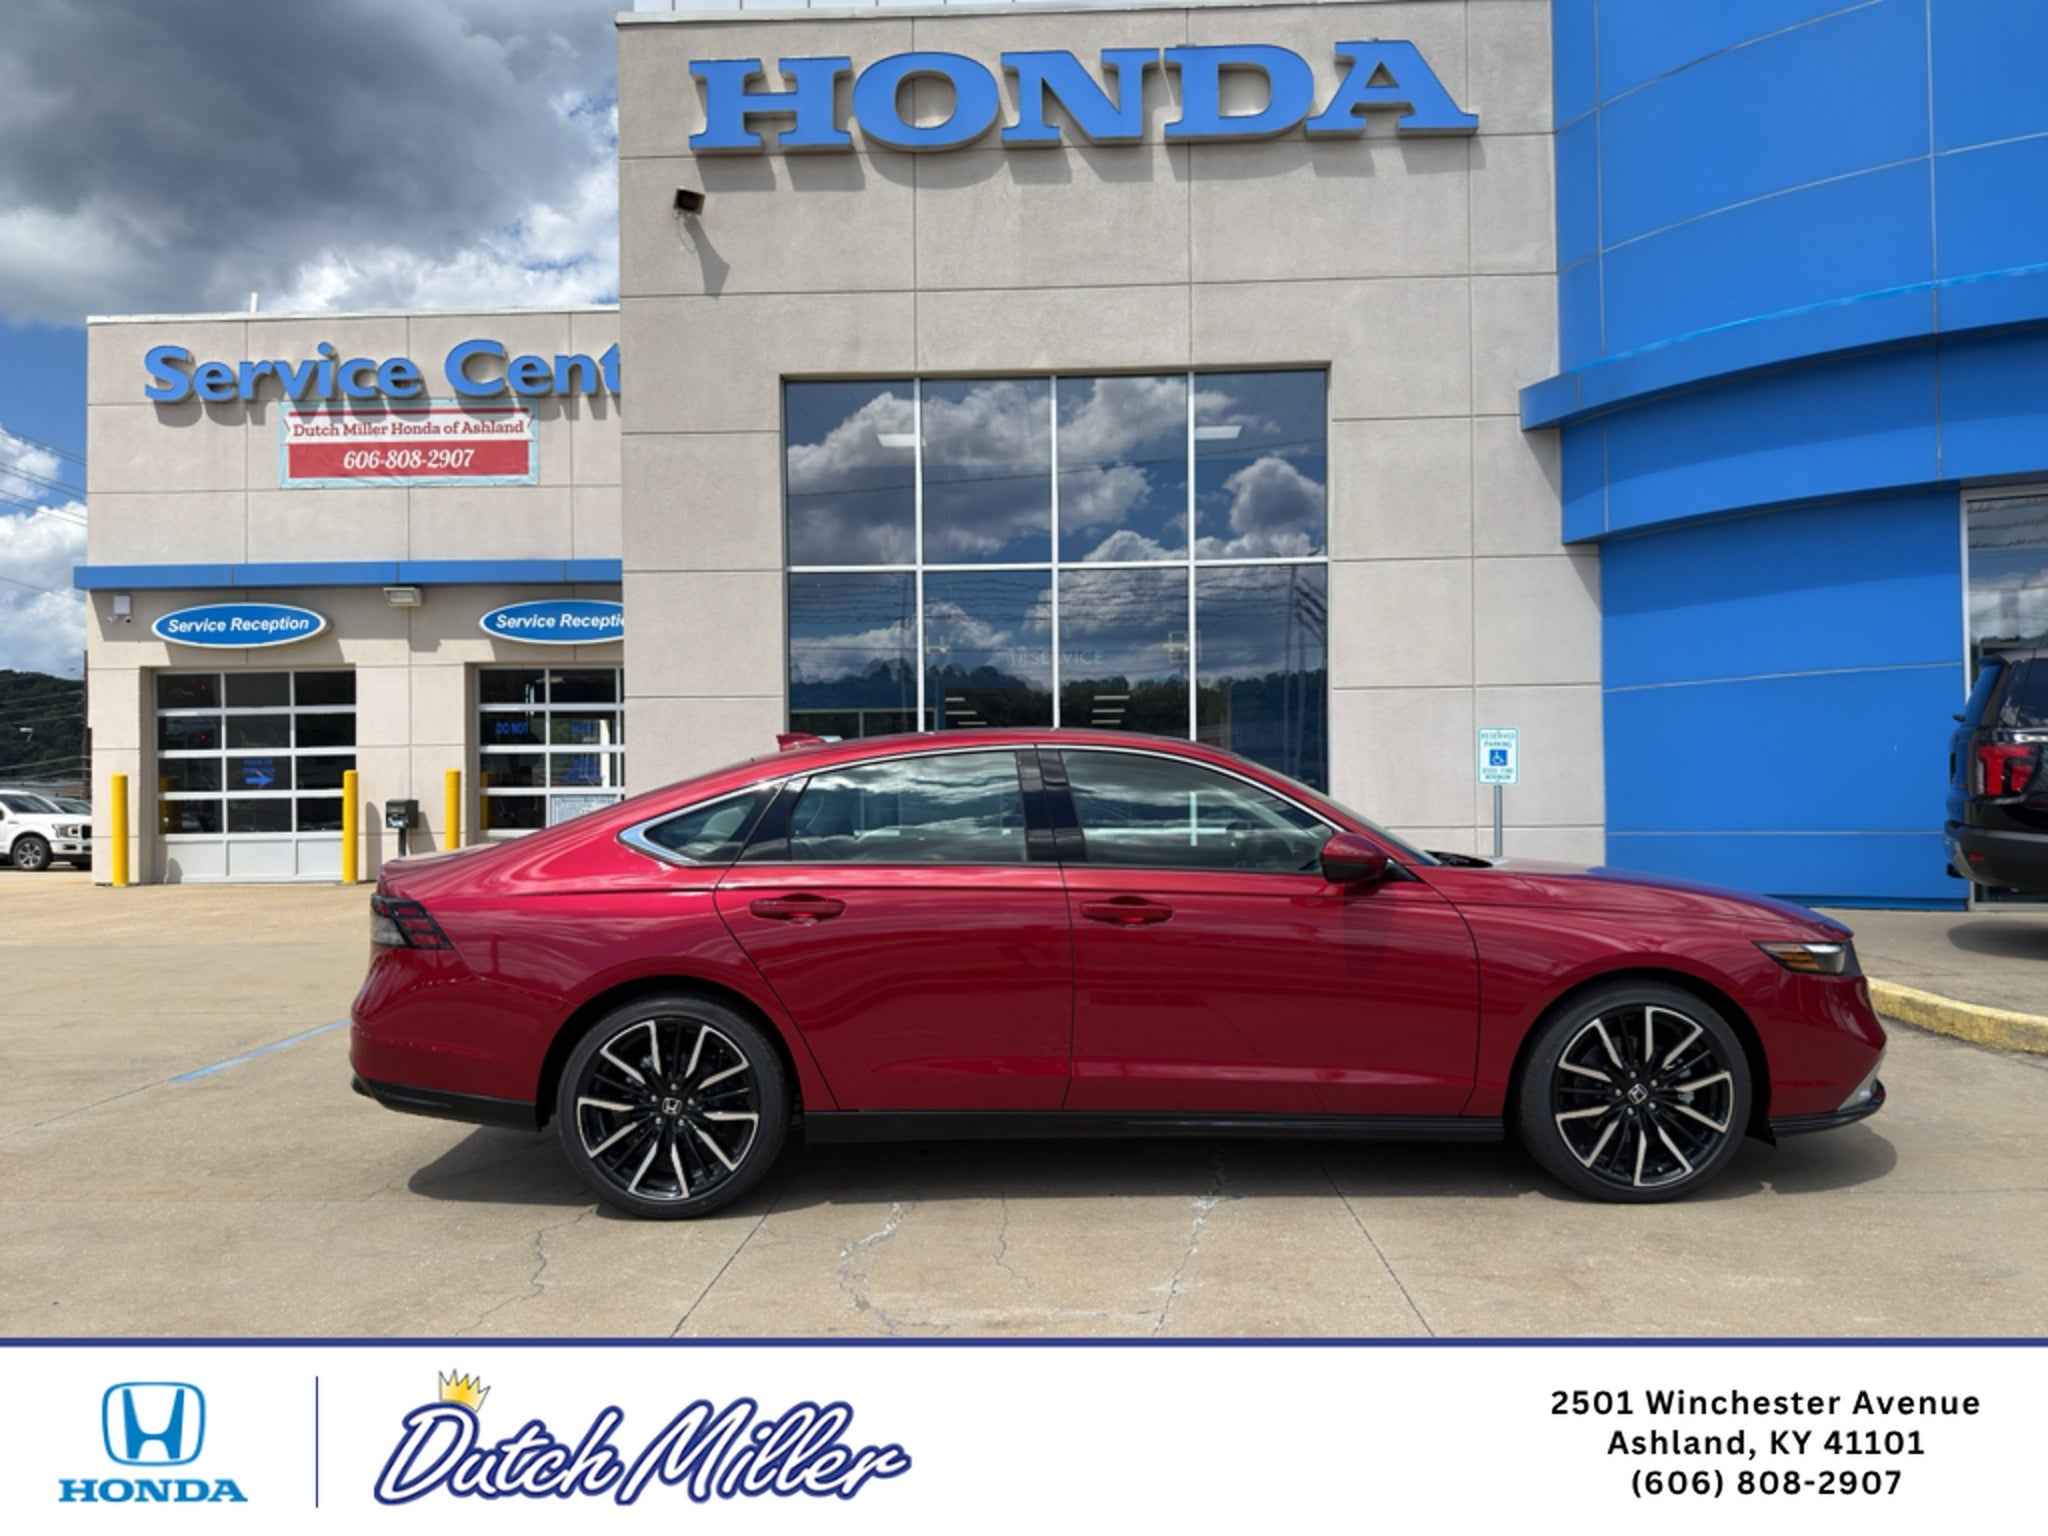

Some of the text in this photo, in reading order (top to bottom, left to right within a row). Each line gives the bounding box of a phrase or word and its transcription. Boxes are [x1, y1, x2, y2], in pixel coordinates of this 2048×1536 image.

[689, 38, 1479, 153] HONDA
[145, 343, 418, 400] Service
[293, 417, 525, 437] Dutch Miller Honda of Ashland
[343, 450, 475, 469] 606-808-2907
[167, 615, 309, 633] Service Reception
[495, 613, 556, 629] Service
